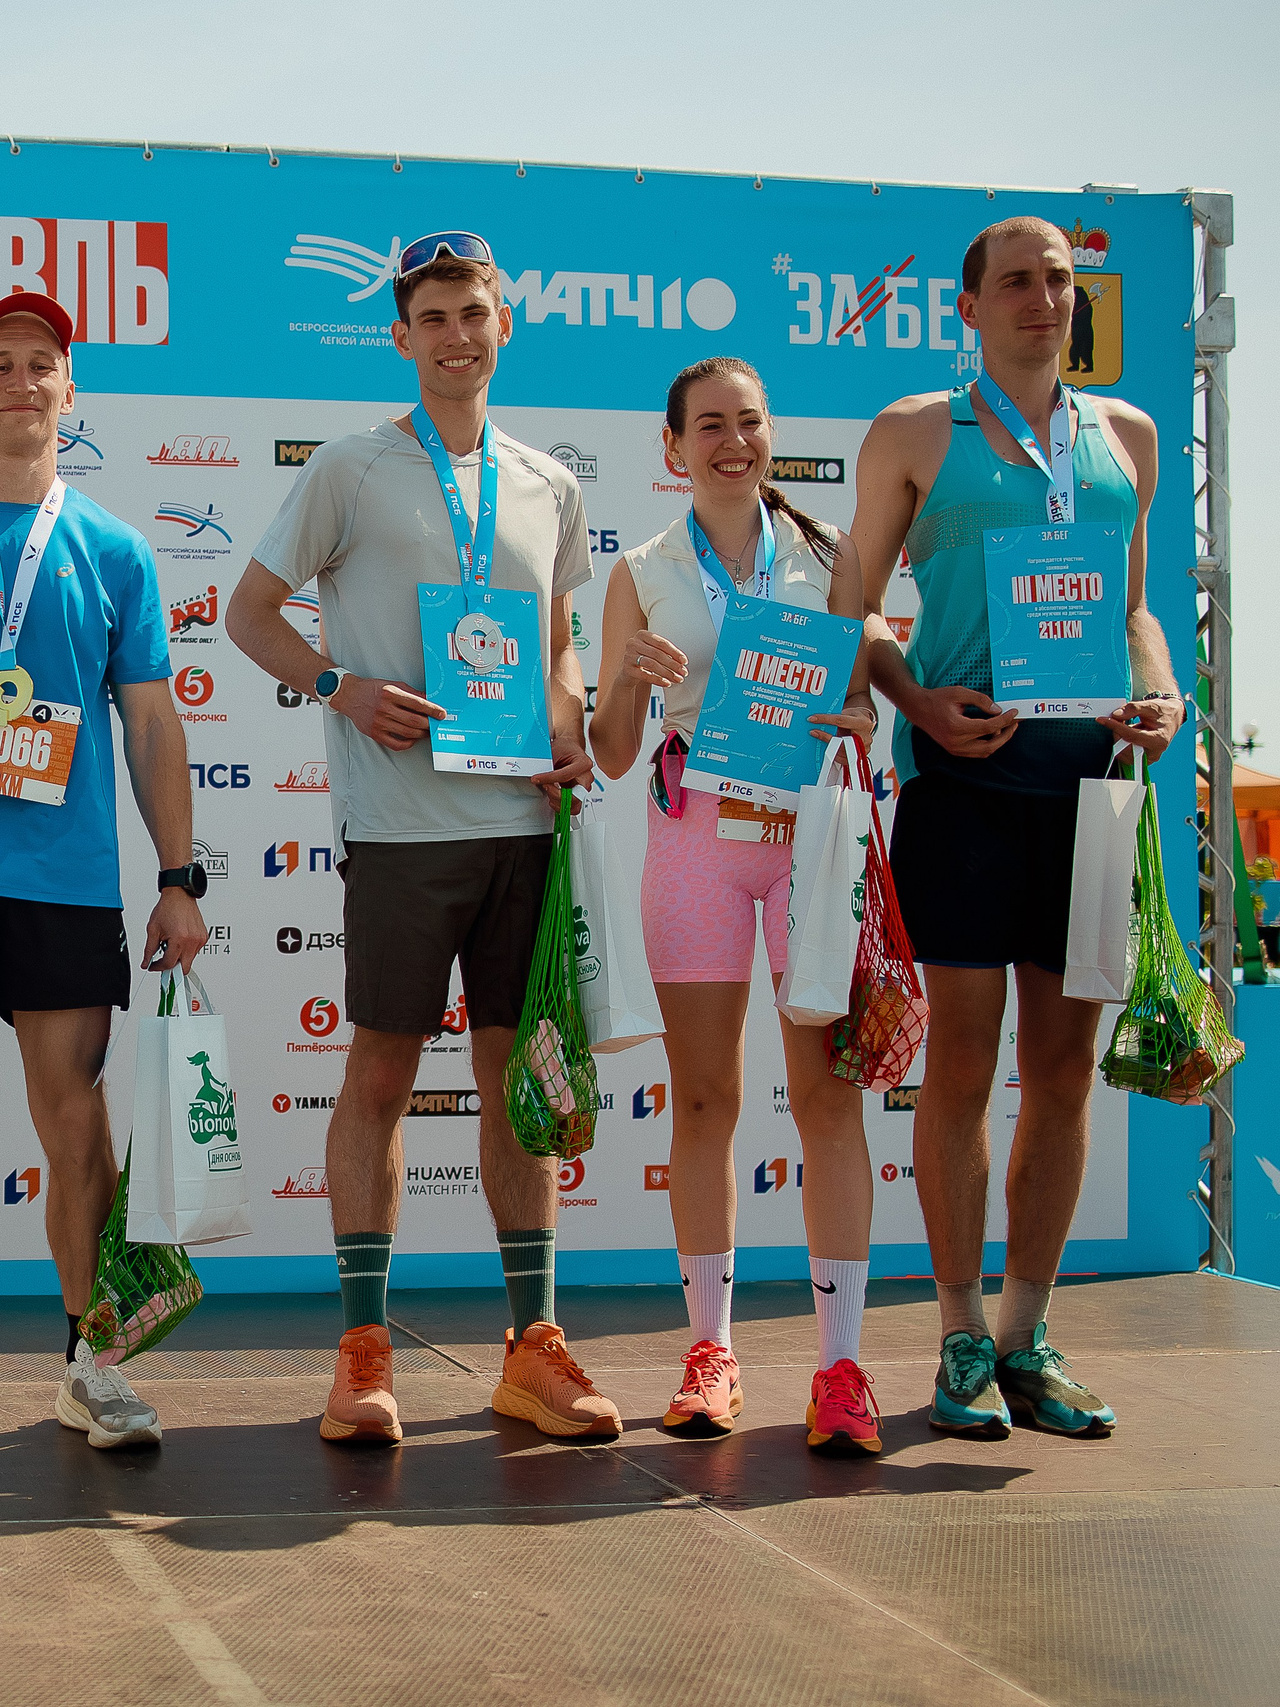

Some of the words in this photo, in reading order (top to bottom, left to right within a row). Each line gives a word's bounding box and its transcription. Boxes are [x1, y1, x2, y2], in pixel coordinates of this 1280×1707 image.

[289, 322, 378, 336] ВСЕРОССИЙСКАЯ
[320, 335, 357, 346] ЛЕГКОЙ
[359, 336, 395, 347] АТЛЕТИ
[487, 438, 495, 458] ПСБ
[451, 494, 461, 516] ПСБ
[478, 553, 487, 575] ПСБ
[1011, 575, 1033, 605] III
[1034, 572, 1104, 603] МЕСТО
[170, 592, 207, 609] ENERGY
[11, 601, 23, 624] ПСБ
[1038, 621, 1062, 642] 21,1
[1062, 620, 1082, 639] КМ
[735, 649, 759, 681] III
[759, 656, 828, 697] МЕСТО
[747, 701, 770, 727] 21,1
[768, 706, 795, 729] КМ
[1047, 703, 1069, 713] ПСБ
[177, 712, 228, 724] тёрочка
[478, 760, 498, 770] ПСБ
[732, 784, 753, 796] ПСБ
[306, 932, 346, 951] дзе
[212, 1152, 224, 1165] ДНЯ
[225, 1150, 241, 1165] ОСНОВ
[407, 1166, 480, 1180] HUAWEI
[407, 1182, 449, 1196] WATCH
[451, 1182, 469, 1195] FIT
[470, 1182, 479, 1195] 4
